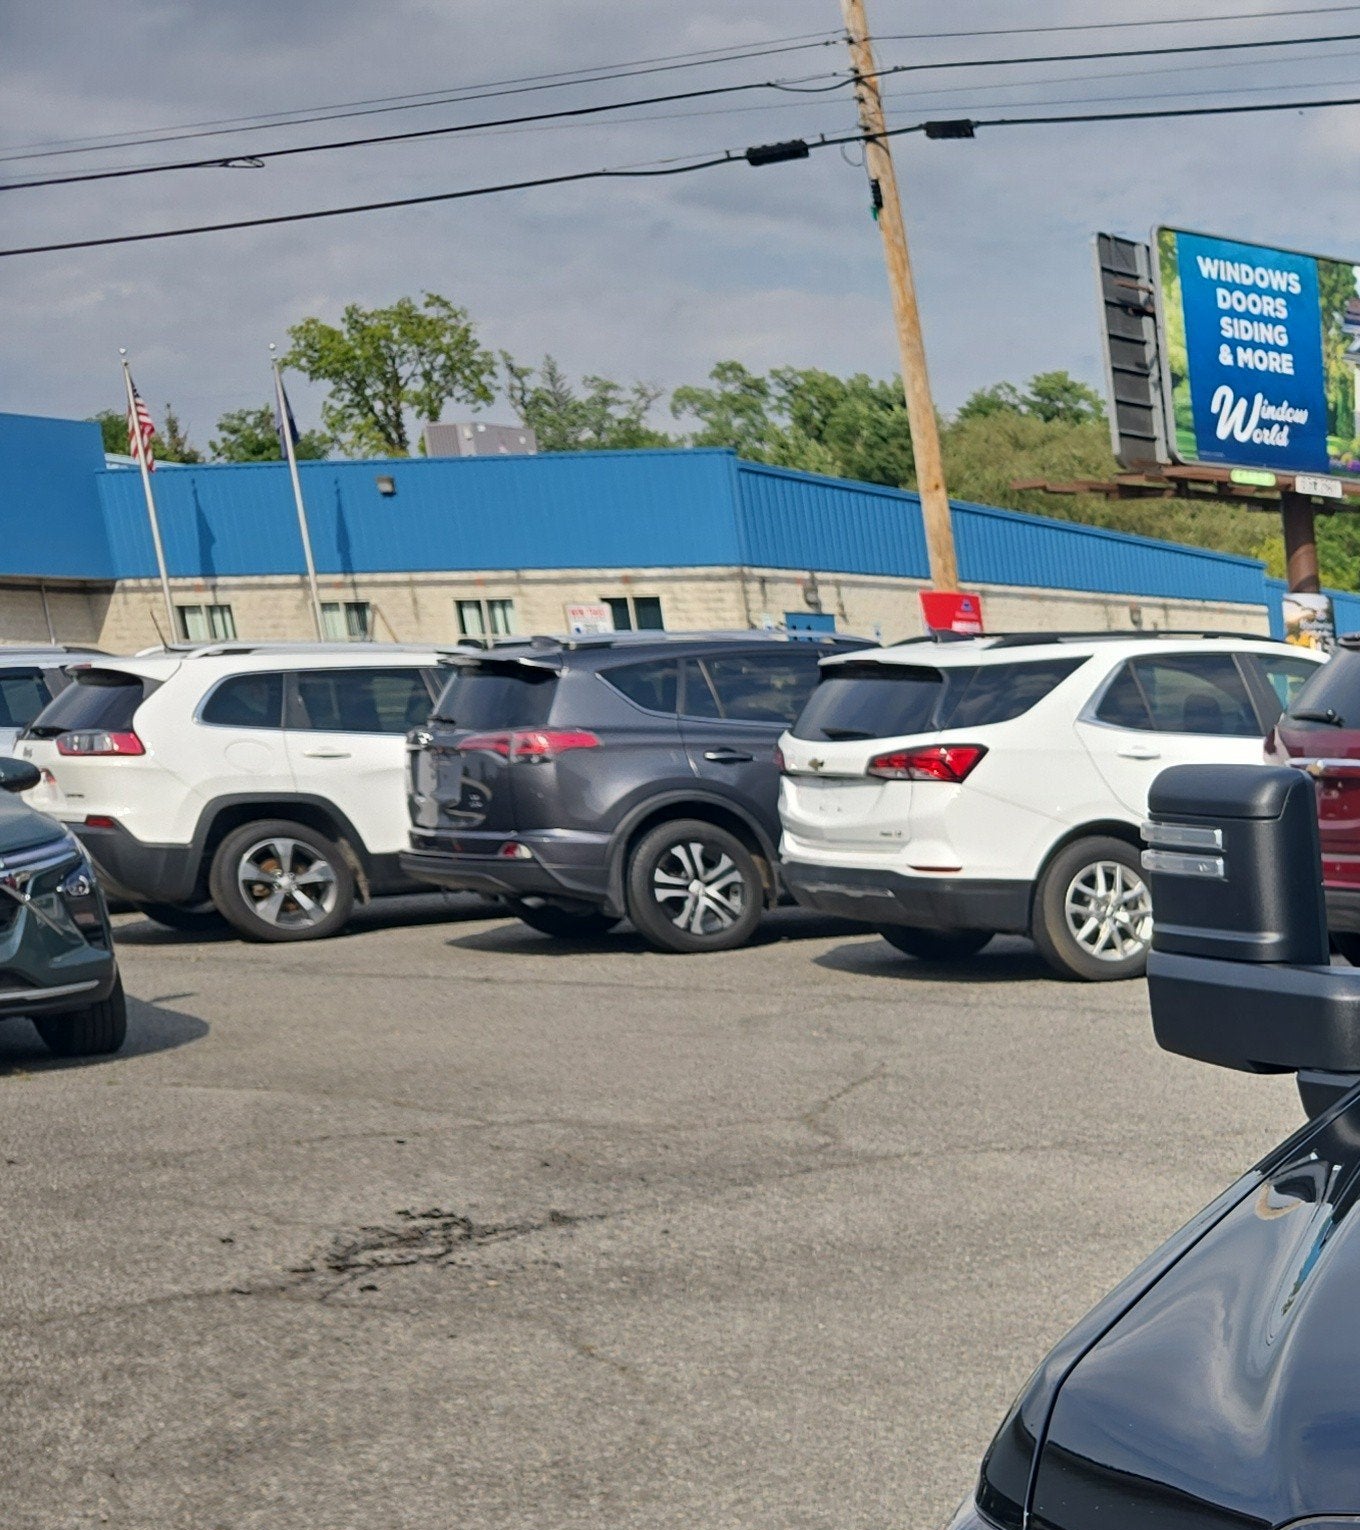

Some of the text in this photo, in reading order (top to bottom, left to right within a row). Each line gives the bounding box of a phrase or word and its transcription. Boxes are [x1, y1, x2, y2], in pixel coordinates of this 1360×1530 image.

[1196, 255, 1301, 295] WINDOWS
[1216, 287, 1288, 319] DOORS
[1220, 316, 1288, 347] SIDING
[1219, 343, 1295, 375] & MORE
[1210, 385, 1309, 434] Window
